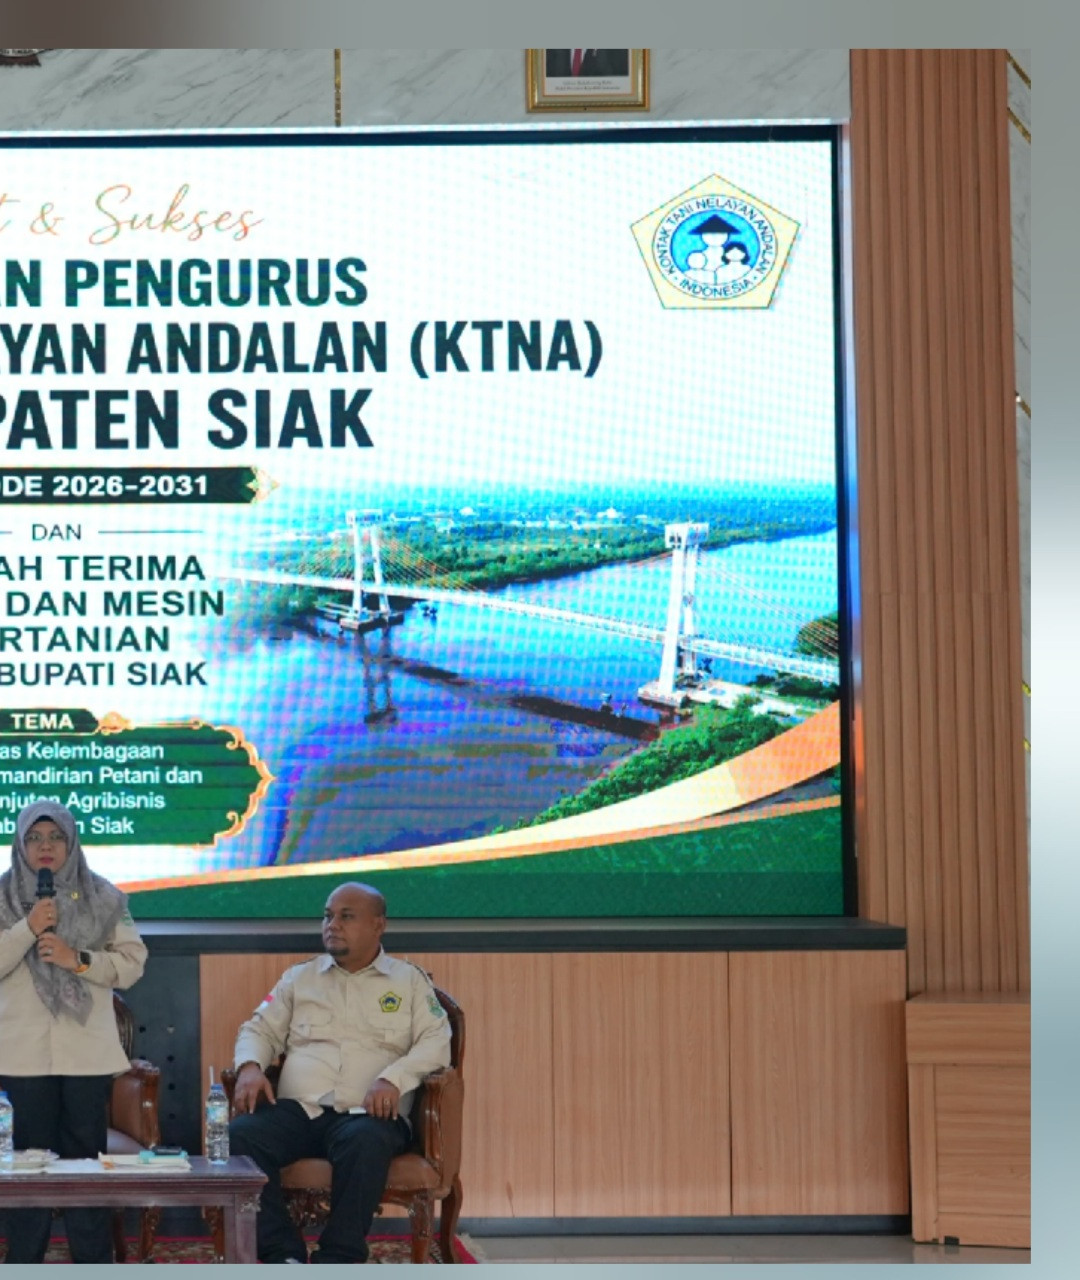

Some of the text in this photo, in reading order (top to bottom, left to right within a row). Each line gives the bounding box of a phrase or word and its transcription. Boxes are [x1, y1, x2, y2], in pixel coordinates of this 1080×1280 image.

[30, 202, 64, 236] &
[89, 184, 263, 244] Sukses
[656, 198, 773, 276] KONTAK TANI NELAYAN ANDALAN
[65, 257, 368, 308] PENGURUS
[679, 278, 753, 297] INDONESIA
[126, 321, 387, 374] ANDALAN
[410, 319, 604, 378] (KTNA)
[207, 387, 374, 449] SIAK
[31, 523, 81, 541] DAN
[57, 555, 205, 581] TERIMA
[6, 591, 87, 616] DAN
[104, 590, 224, 616] MESIN
[127, 662, 207, 686] SIAK
[11, 713, 74, 730] TEMA
[27, 741, 164, 763] Kelembagaan
[99, 766, 160, 784] Petani
[165, 766, 203, 784] dan
[66, 791, 165, 813] Agribisnis
[91, 817, 134, 834] Siak
